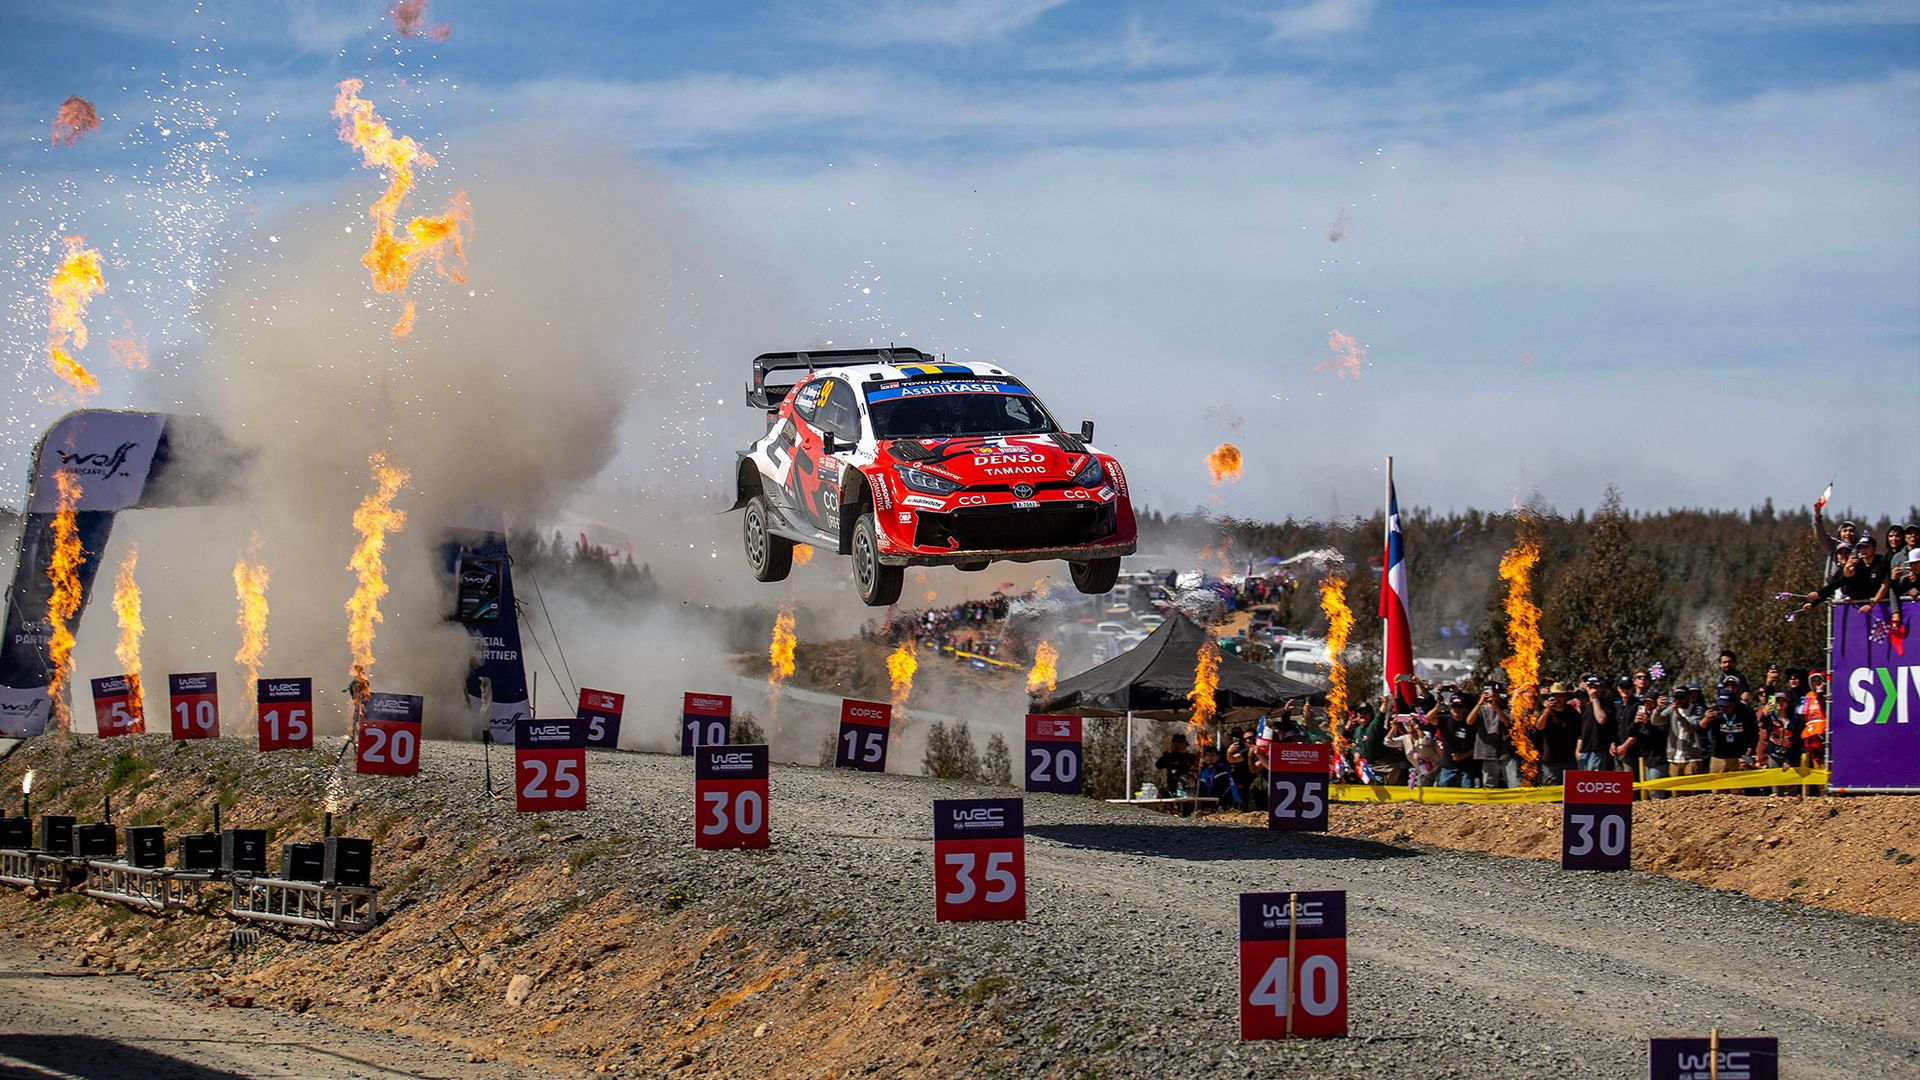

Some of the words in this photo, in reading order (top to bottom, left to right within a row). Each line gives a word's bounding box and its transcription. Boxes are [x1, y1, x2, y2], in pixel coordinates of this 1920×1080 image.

[817, 379, 834, 408] 99
[974, 454, 1045, 466] DENSO
[984, 466, 1046, 476] TAMADIC
[868, 474, 885, 512] AUTOMOTIVE
[876, 473, 891, 509] Panasonic
[959, 495, 987, 505] CCI
[1064, 490, 1090, 499] CCI
[179, 677, 207, 686] WRC
[269, 683, 300, 692] WRC
[111, 702, 131, 728] 5
[175, 701, 215, 730] 10
[374, 700, 409, 710] WRC
[850, 708, 883, 719] COPEC
[263, 710, 308, 741] 15
[530, 725, 570, 736] WRC
[587, 716, 606, 741] 5
[687, 720, 725, 746] 10
[362, 728, 415, 765] 20
[712, 753, 753, 764] WRC
[843, 730, 882, 763] 15
[1281, 750, 1319, 759] SERNATUR
[1031, 748, 1077, 783] 20
[522, 759, 580, 799] 25
[1576, 782, 1621, 793] COPEC
[702, 790, 762, 835] 30
[1275, 781, 1323, 819] 25
[953, 808, 1004, 820] WRC
[1569, 814, 1625, 856] 30
[945, 852, 1017, 904] 35
[1263, 902, 1323, 917] WRC
[1249, 955, 1339, 1016] 40
[1678, 1052, 1750, 1070] WRC
